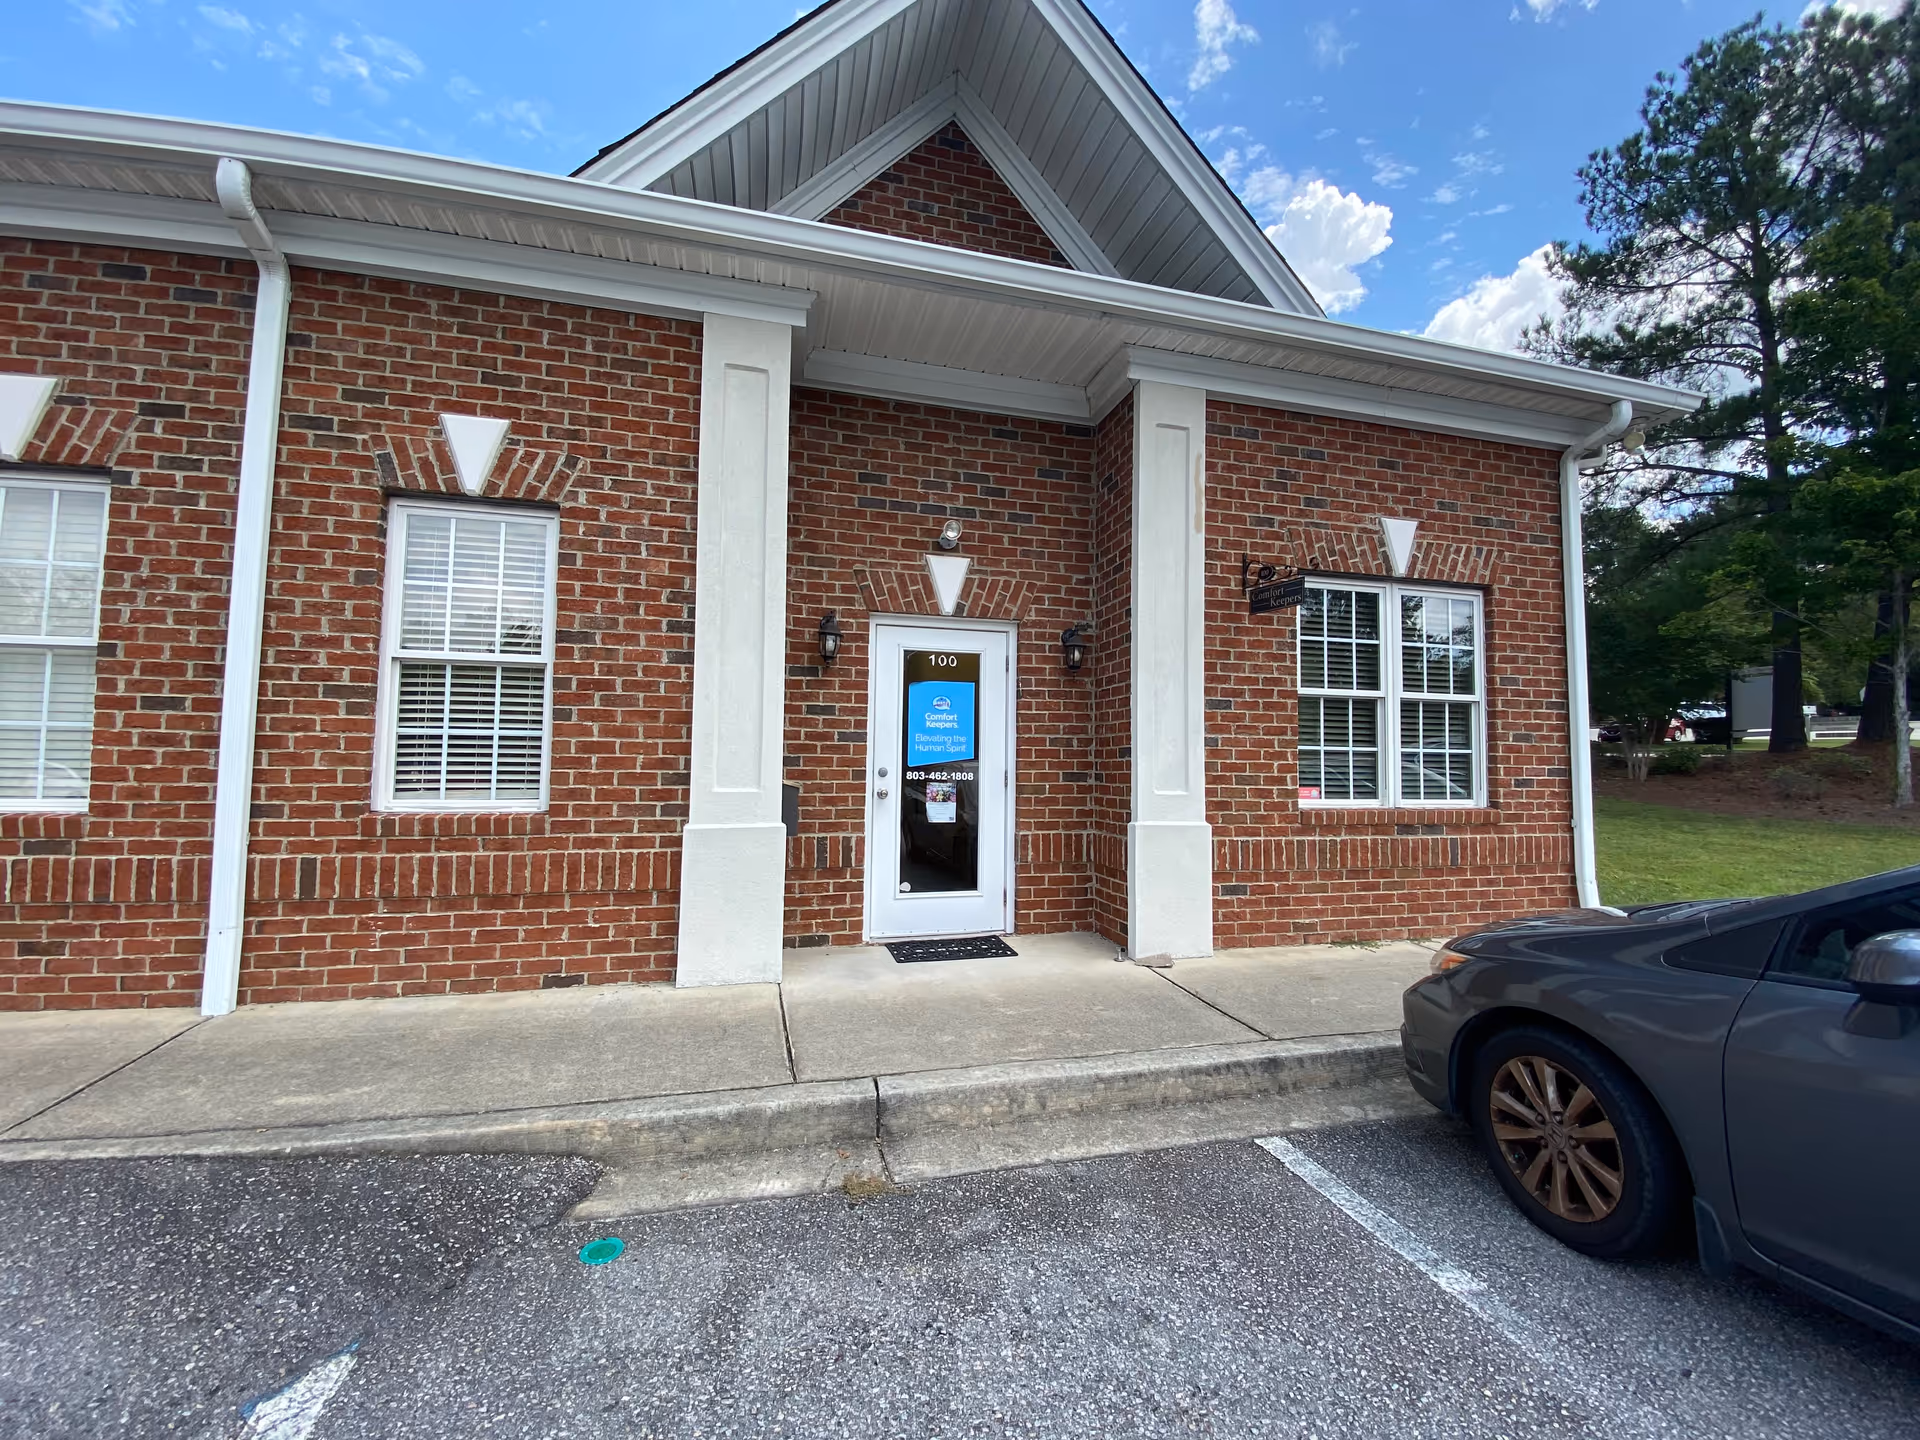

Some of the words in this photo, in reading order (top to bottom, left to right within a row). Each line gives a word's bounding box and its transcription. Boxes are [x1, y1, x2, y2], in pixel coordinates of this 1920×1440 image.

[1252, 587, 1284, 601] Comfort
[1270, 594, 1302, 607] Keepers
[928, 654, 957, 667] 100
[925, 712, 958, 721] Comfort
[926, 720, 958, 729] Keepers
[915, 733, 952, 744] Elevating
[953, 734, 967, 743] the
[915, 743, 945, 752] Human
[946, 743, 967, 753] Spirit
[906, 771, 974, 781] 803-462-1808
